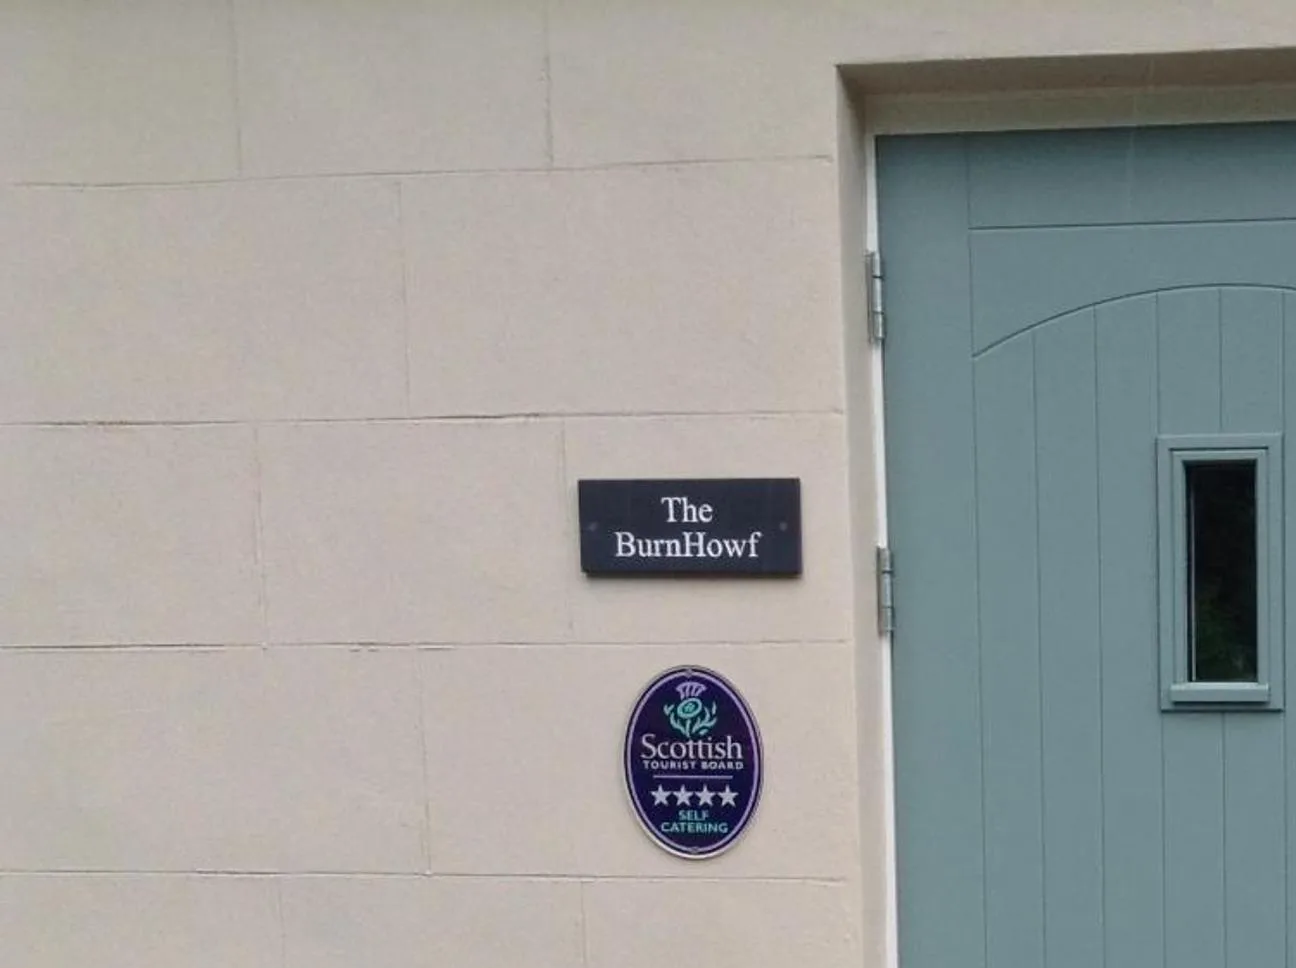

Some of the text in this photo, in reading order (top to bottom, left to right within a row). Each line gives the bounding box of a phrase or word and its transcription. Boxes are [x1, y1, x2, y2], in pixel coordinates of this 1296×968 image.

[661, 497, 713, 523] The
[614, 531, 763, 558] BurnHowf
[640, 733, 743, 760] Scottish
[643, 760, 744, 770] TOURIST BOARD
[678, 809, 710, 821] SELF
[661, 821, 729, 834] CATERING
